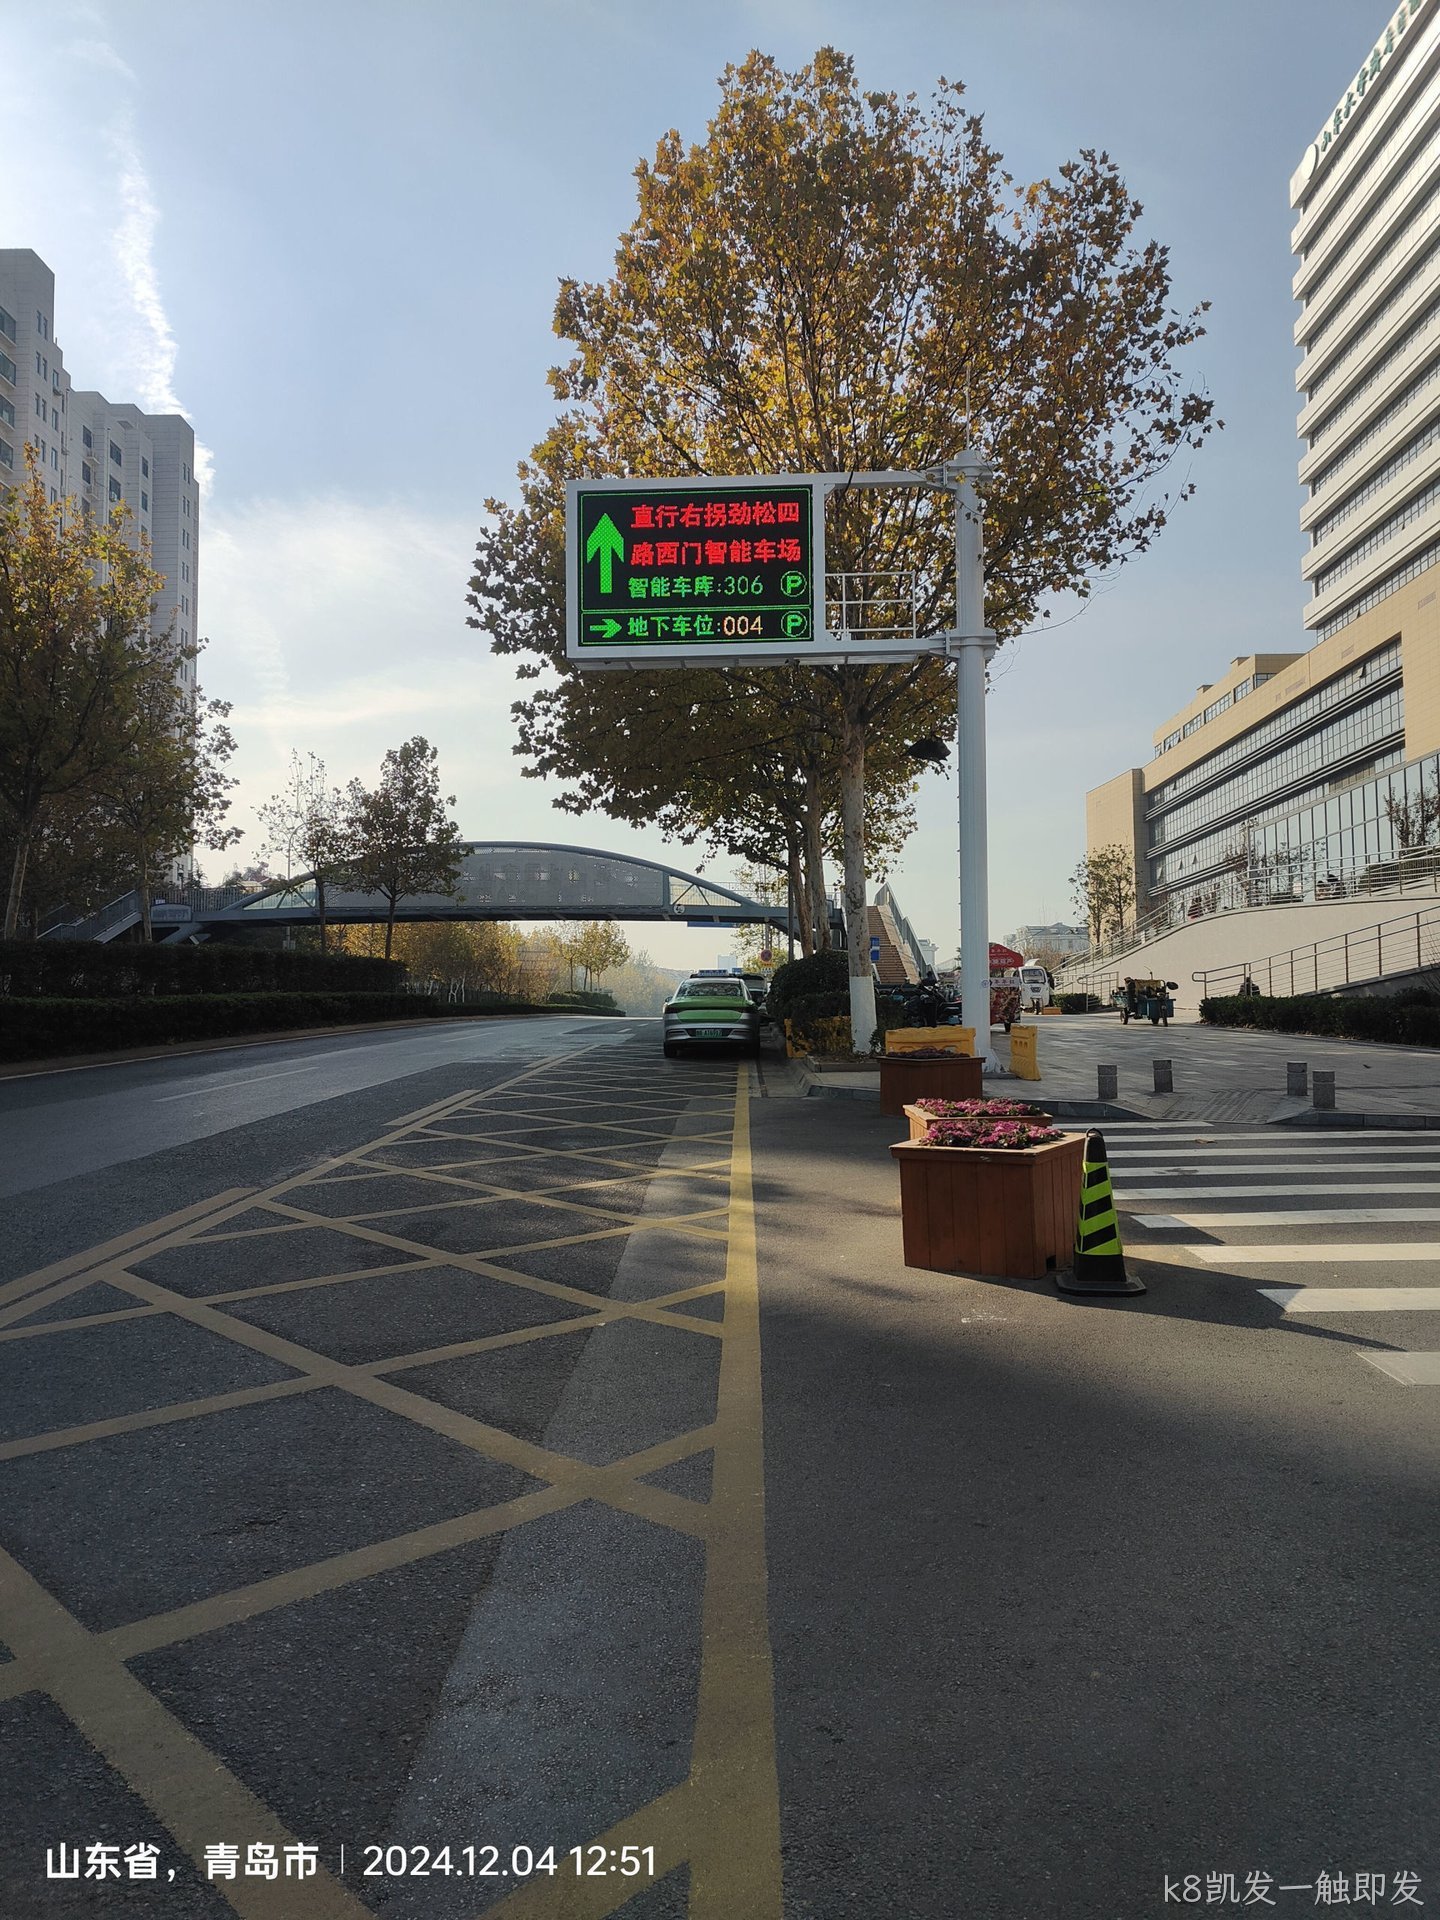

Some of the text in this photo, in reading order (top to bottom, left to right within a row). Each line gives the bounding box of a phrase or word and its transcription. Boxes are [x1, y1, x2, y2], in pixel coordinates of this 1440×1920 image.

[631, 501, 799, 528] 直行右拐劲松四
[631, 539, 801, 566] 路西门智能车场
